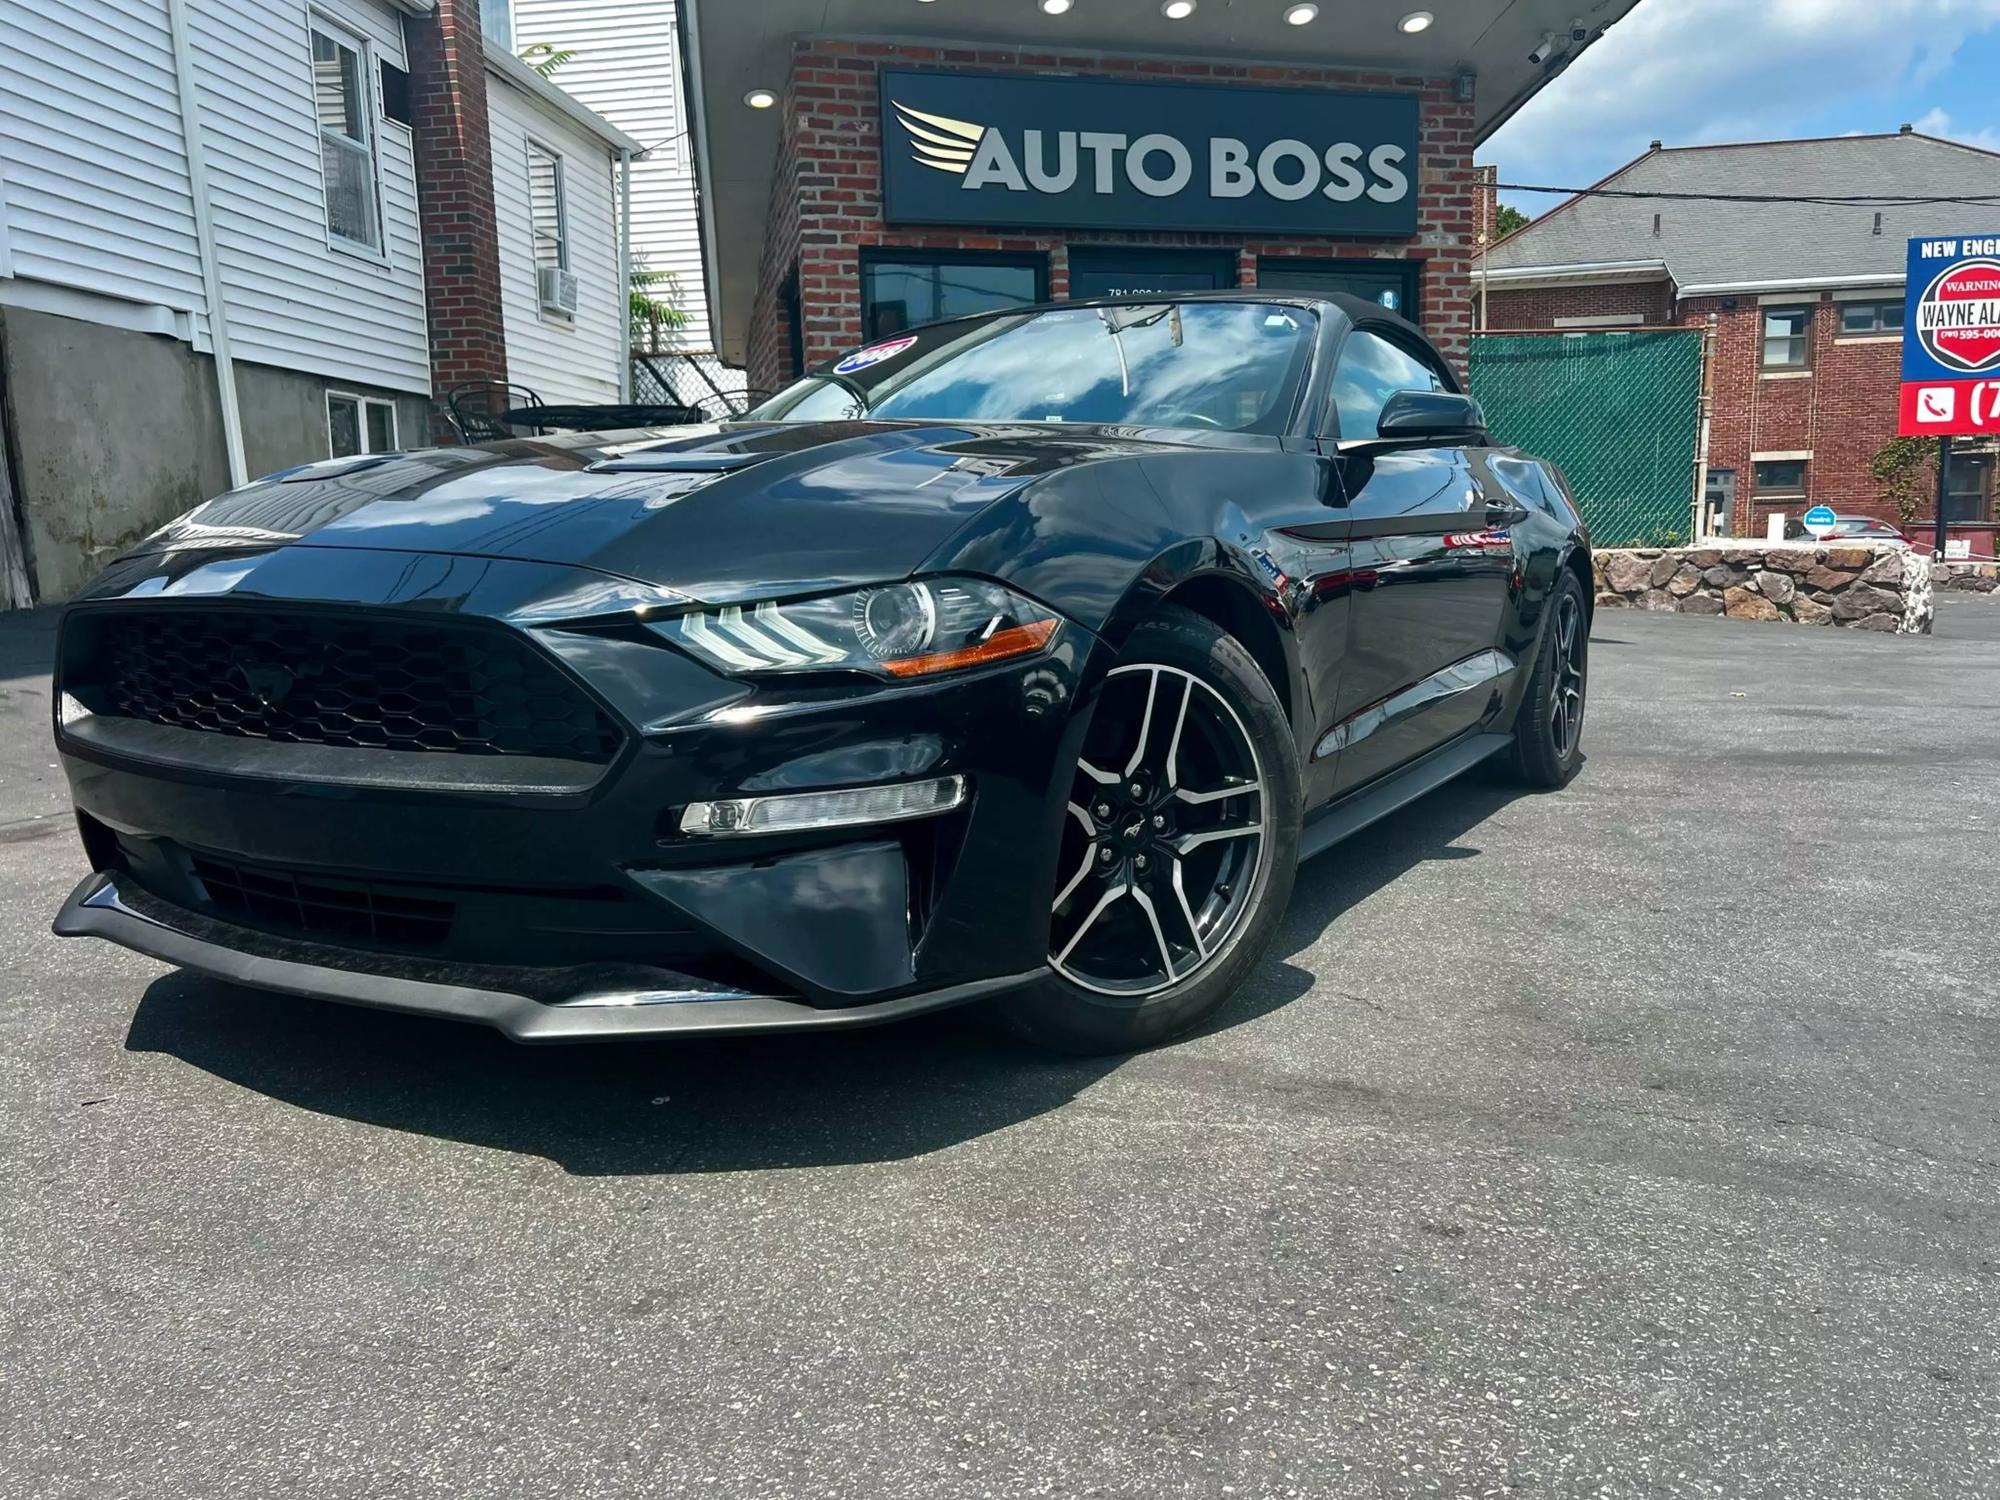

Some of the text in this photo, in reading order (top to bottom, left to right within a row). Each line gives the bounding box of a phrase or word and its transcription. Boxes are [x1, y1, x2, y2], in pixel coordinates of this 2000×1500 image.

[961, 127, 1408, 203] AUTO BOSS
[1921, 241, 1957, 258] NEW
[1946, 280, 2000, 292] WARNIN
[1923, 302, 1975, 327] WAYNE
